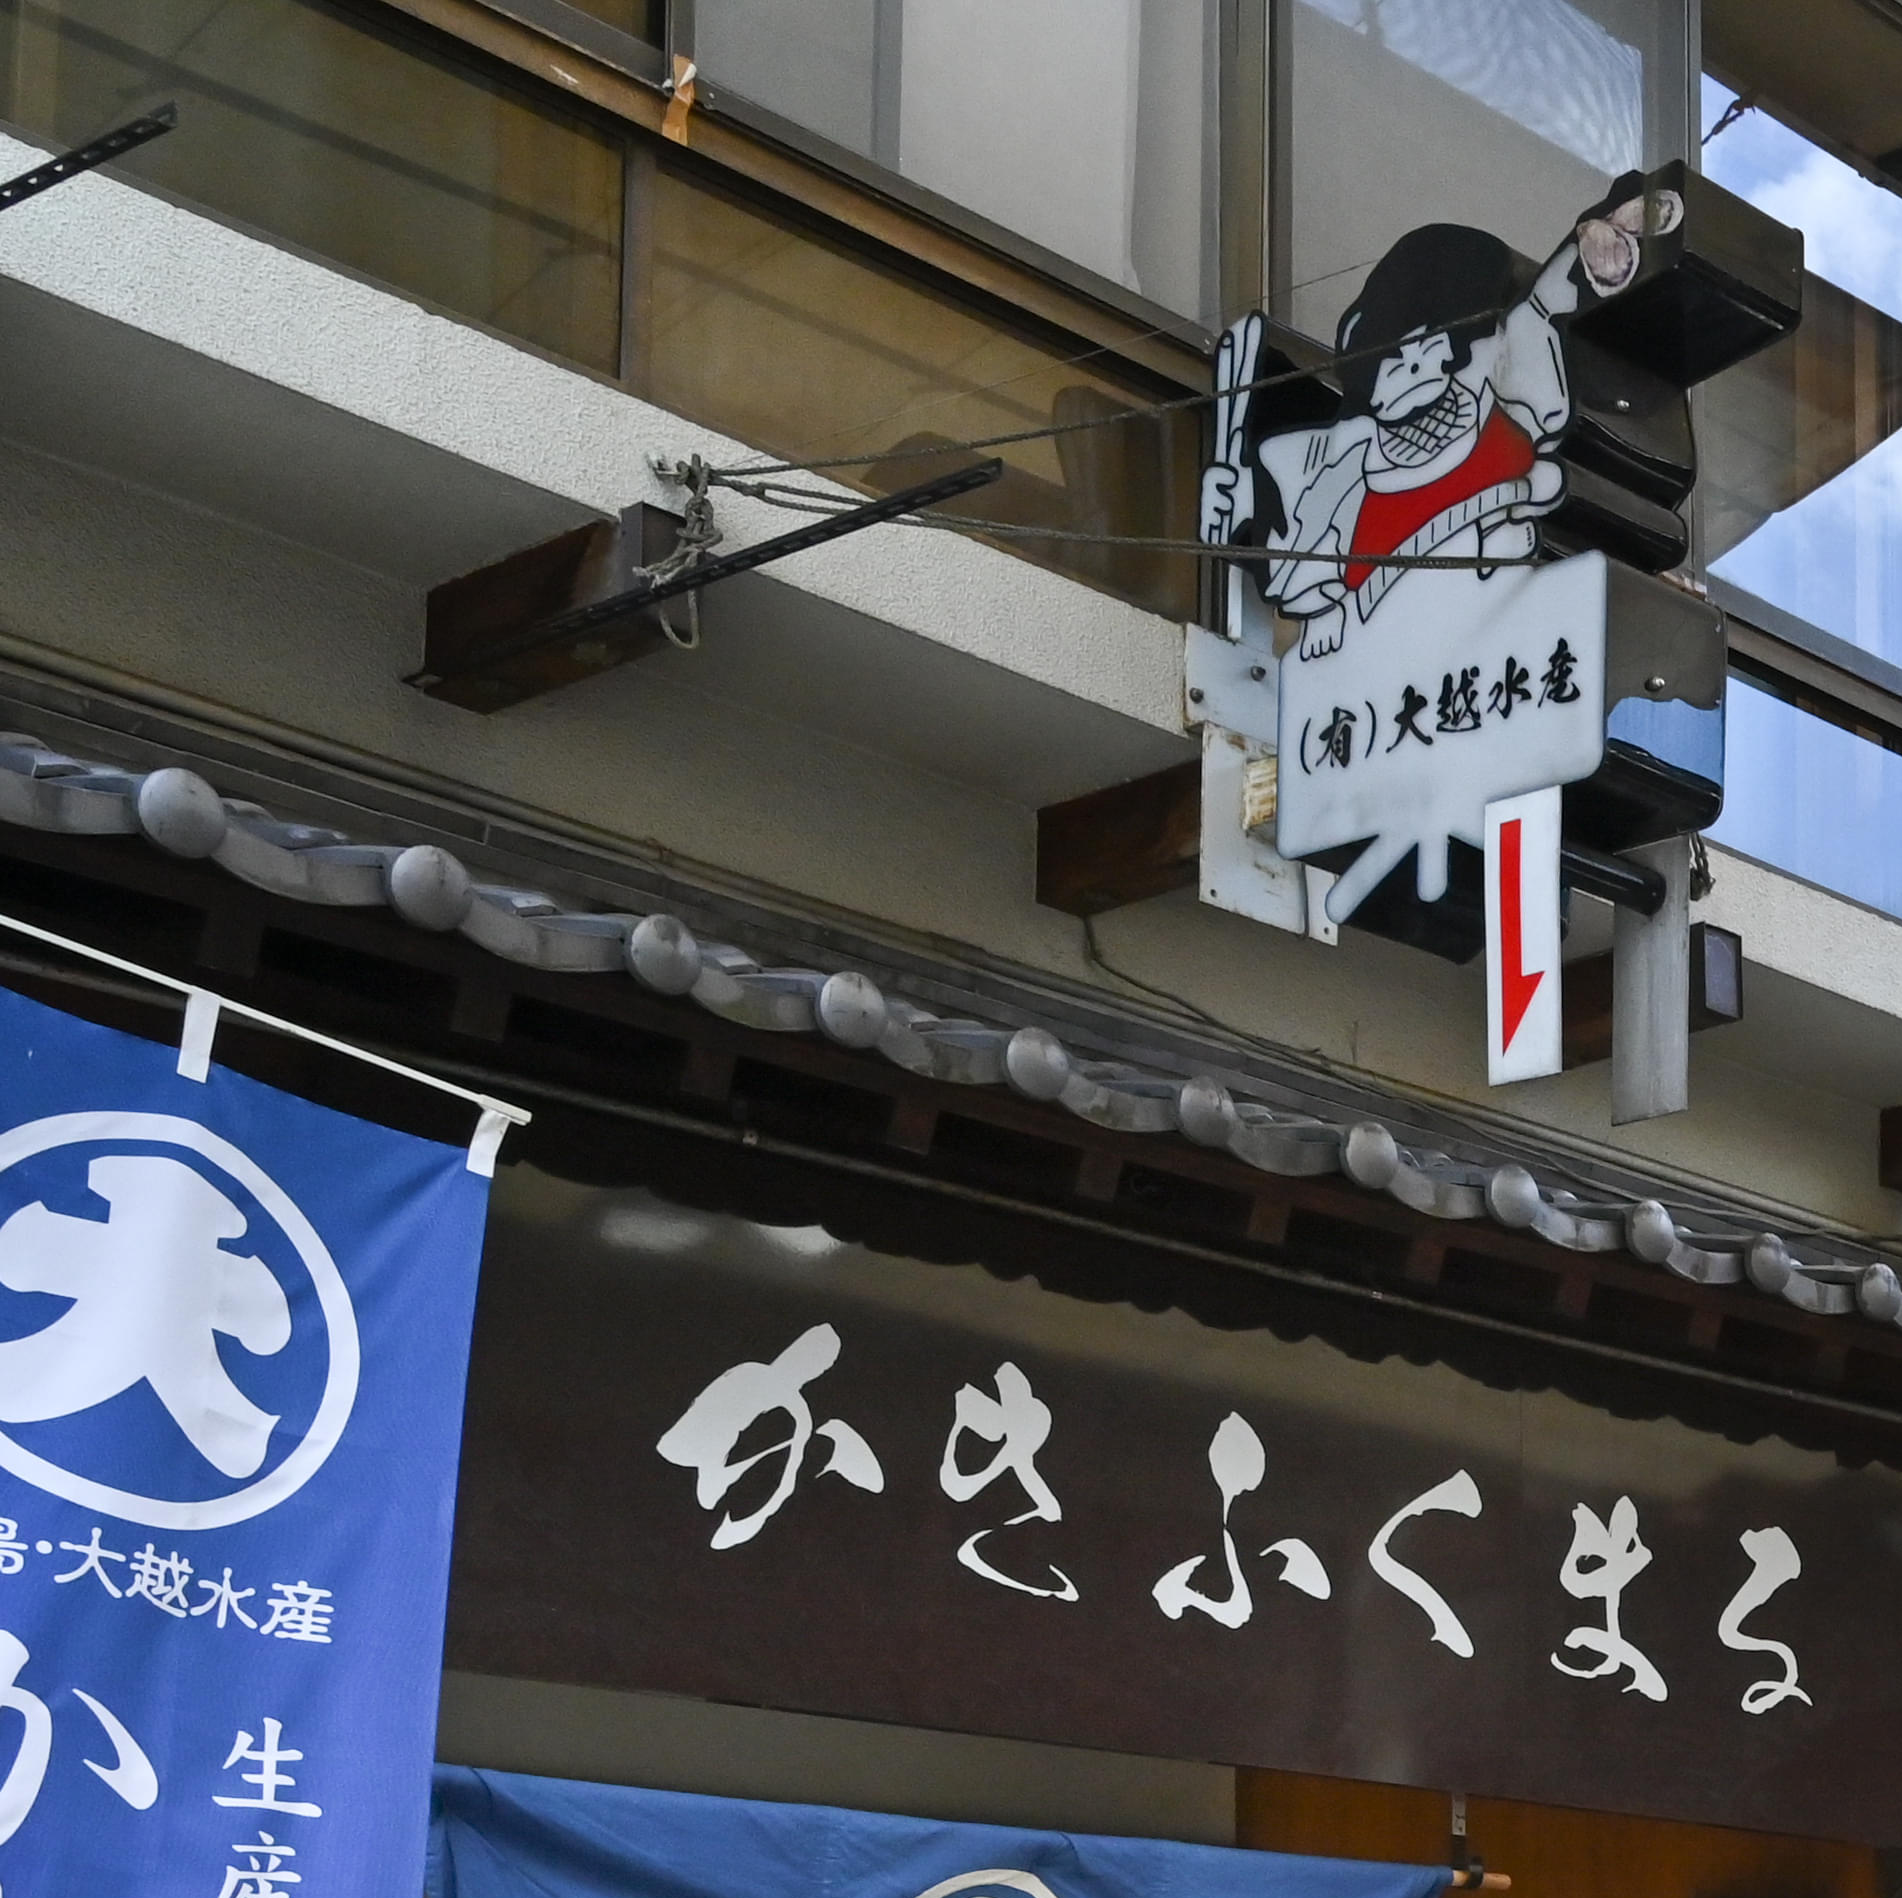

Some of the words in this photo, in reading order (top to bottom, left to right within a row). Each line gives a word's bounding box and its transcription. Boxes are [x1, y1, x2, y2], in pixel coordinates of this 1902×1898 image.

[655, 1321, 1814, 1717] かきふくまる
